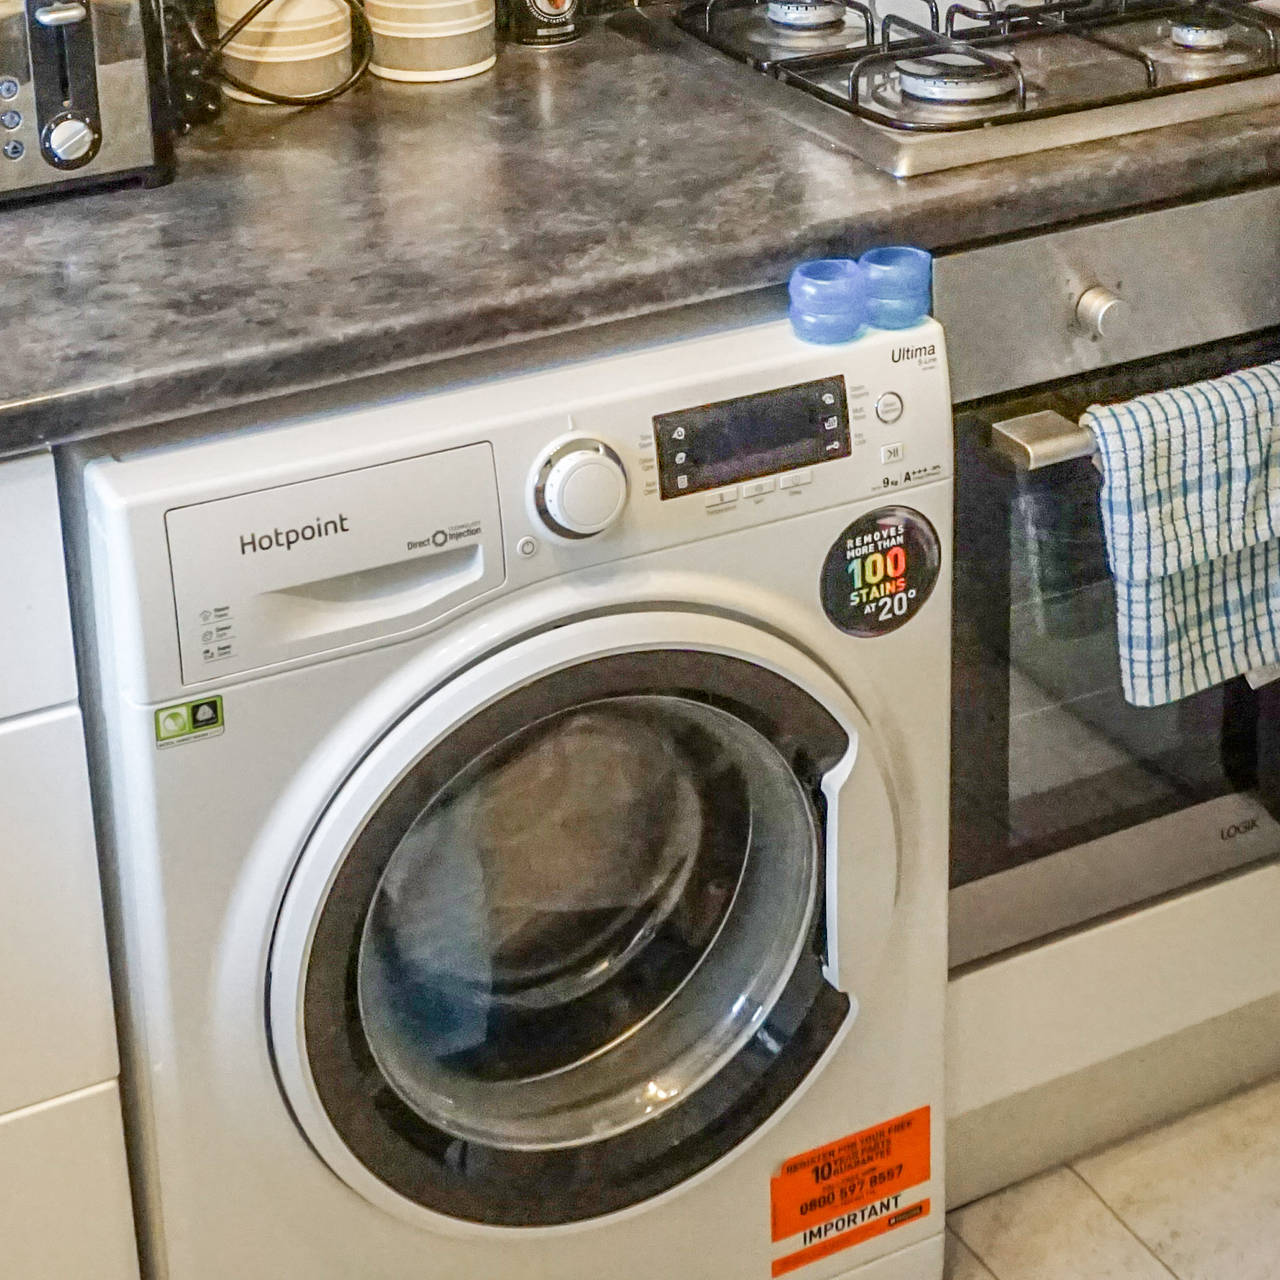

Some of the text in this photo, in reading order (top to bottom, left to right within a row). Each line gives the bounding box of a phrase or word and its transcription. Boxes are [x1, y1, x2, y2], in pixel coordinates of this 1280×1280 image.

[891, 344, 936, 363] Ultima
[240, 513, 350, 555] Hotpoint
[407, 537, 431, 551] Direct
[846, 524, 905, 549] REMOVES
[846, 535, 904, 560] MORE THAN
[847, 546, 906, 589] 100
[850, 578, 906, 606] STAINS
[864, 603, 877, 614] AT
[786, 1149, 836, 1175] REGISTER
[860, 1129, 887, 1145] YOUR
[812, 1160, 833, 1184] 10
[799, 1190, 836, 1216] 0800
[802, 1194, 902, 1247] IMPORTANT
